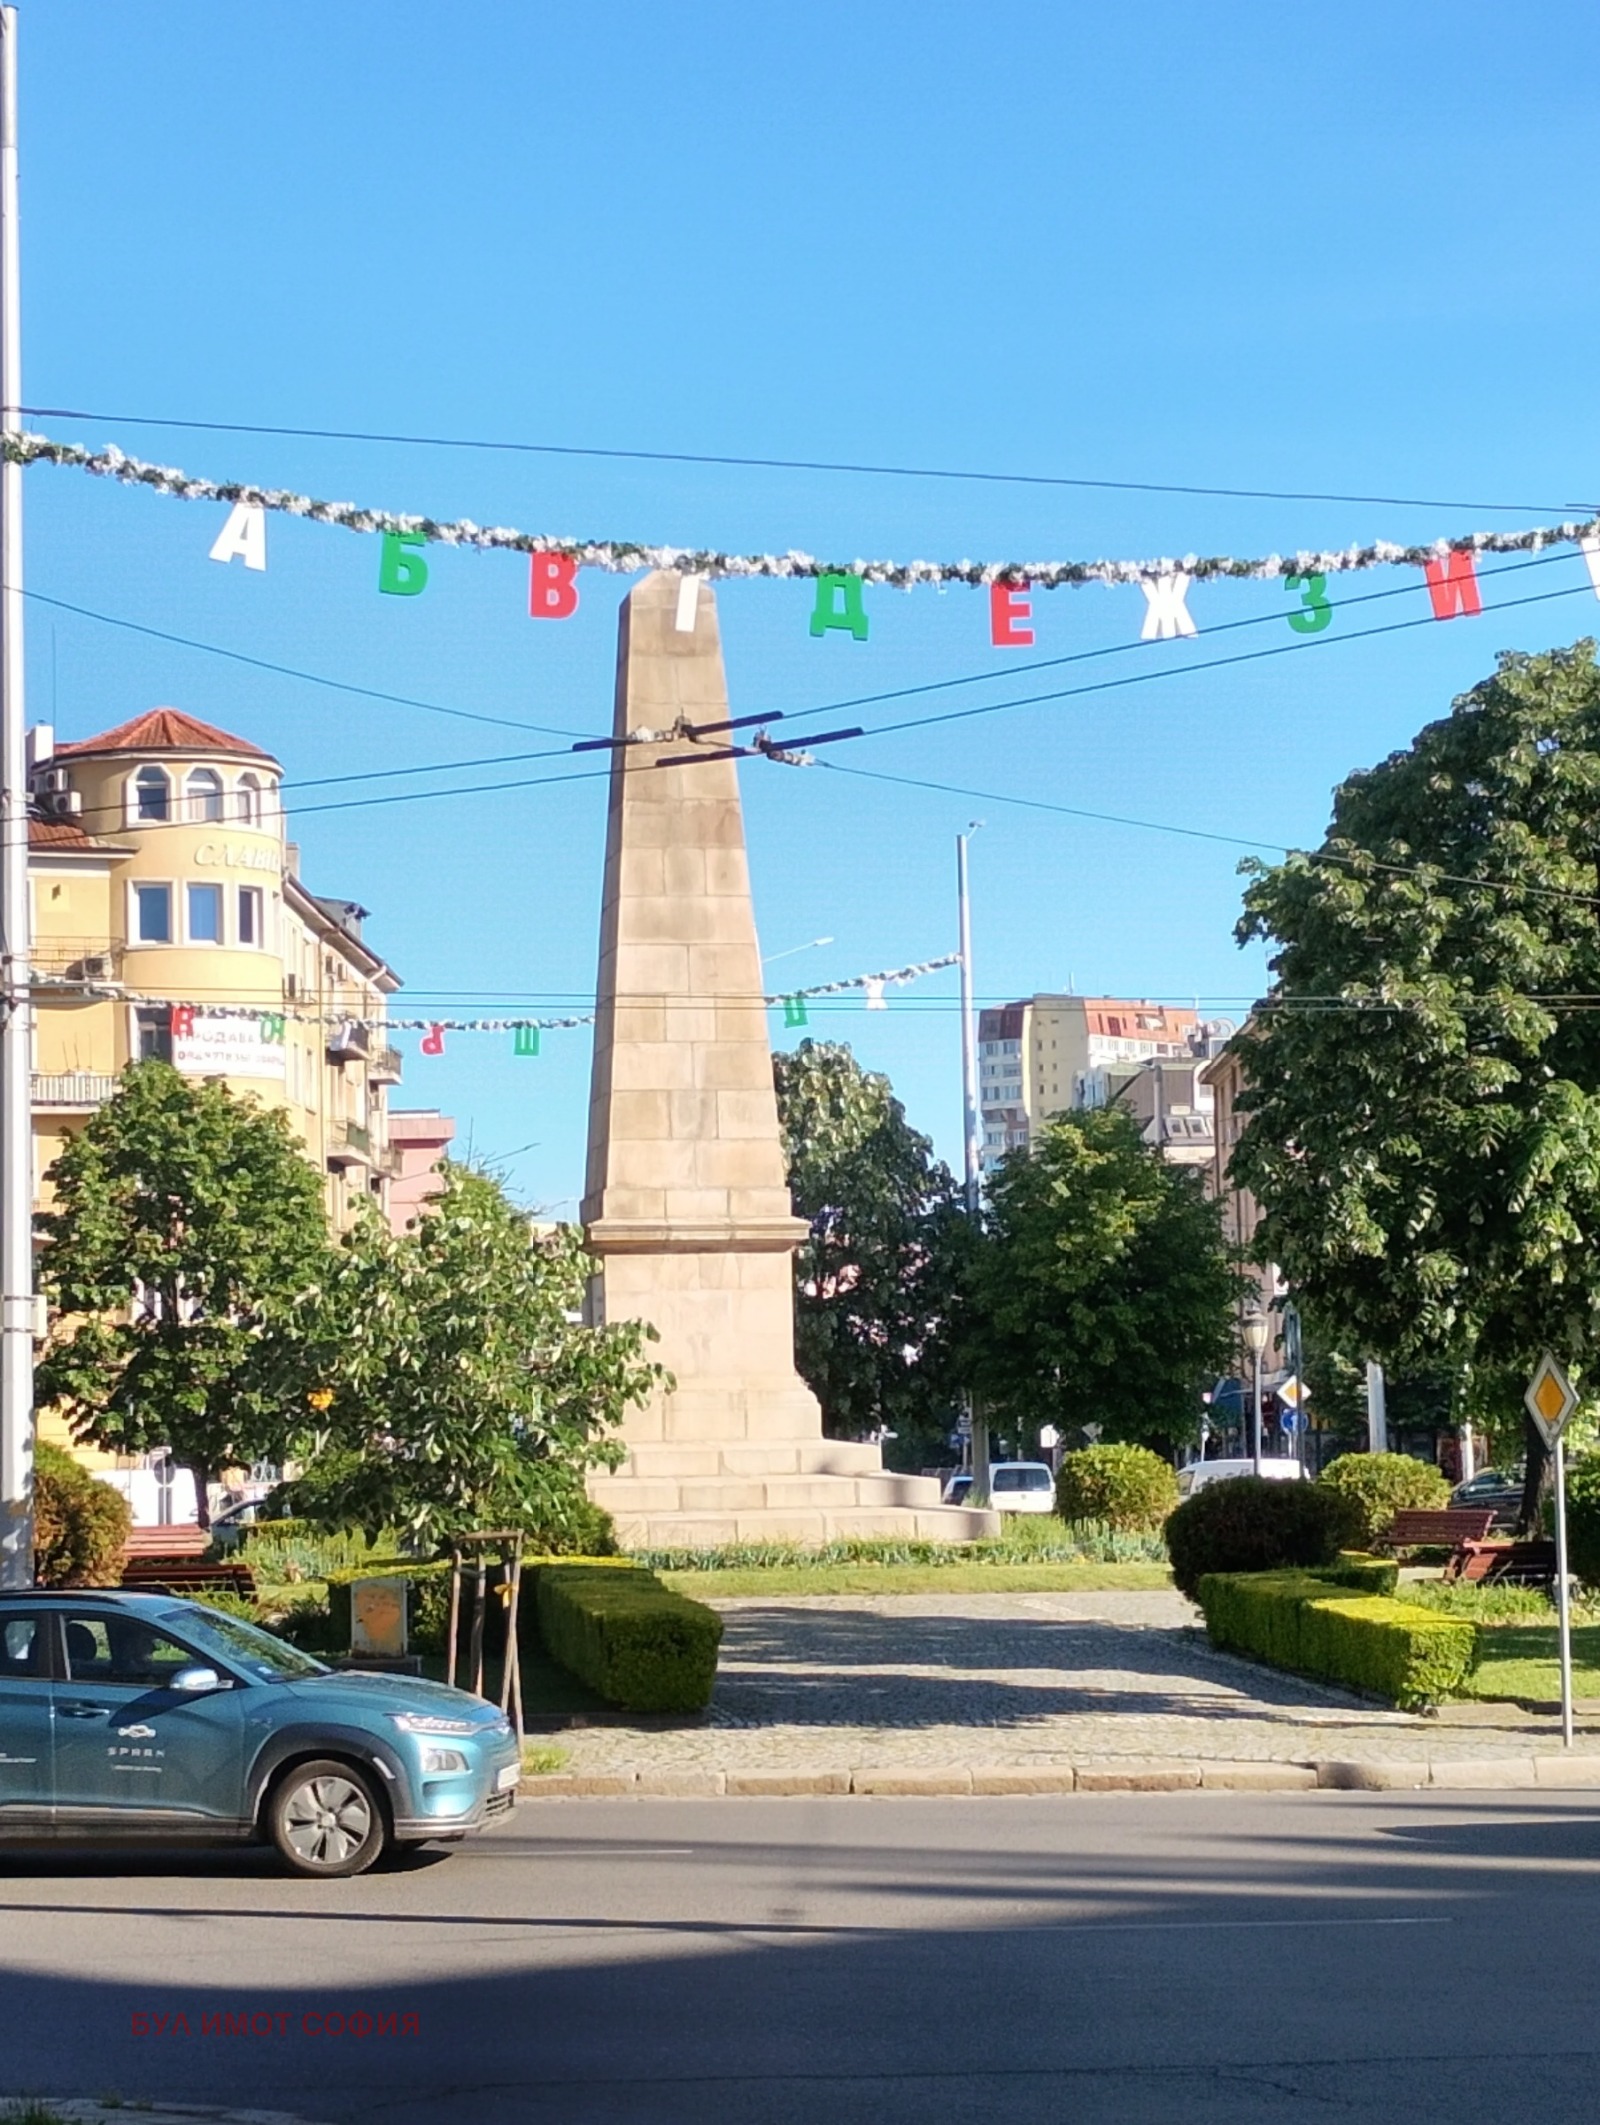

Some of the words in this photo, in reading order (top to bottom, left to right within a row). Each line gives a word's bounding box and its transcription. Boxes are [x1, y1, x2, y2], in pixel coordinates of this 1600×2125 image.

[208, 501, 266, 572] А
[379, 531, 428, 596] Б
[528, 551, 580, 620] В
[810, 573, 869, 641] Д
[989, 579, 1036, 649] Е
[1140, 572, 1199, 639] Ж
[1284, 573, 1332, 634] З
[1423, 549, 1482, 621] И
